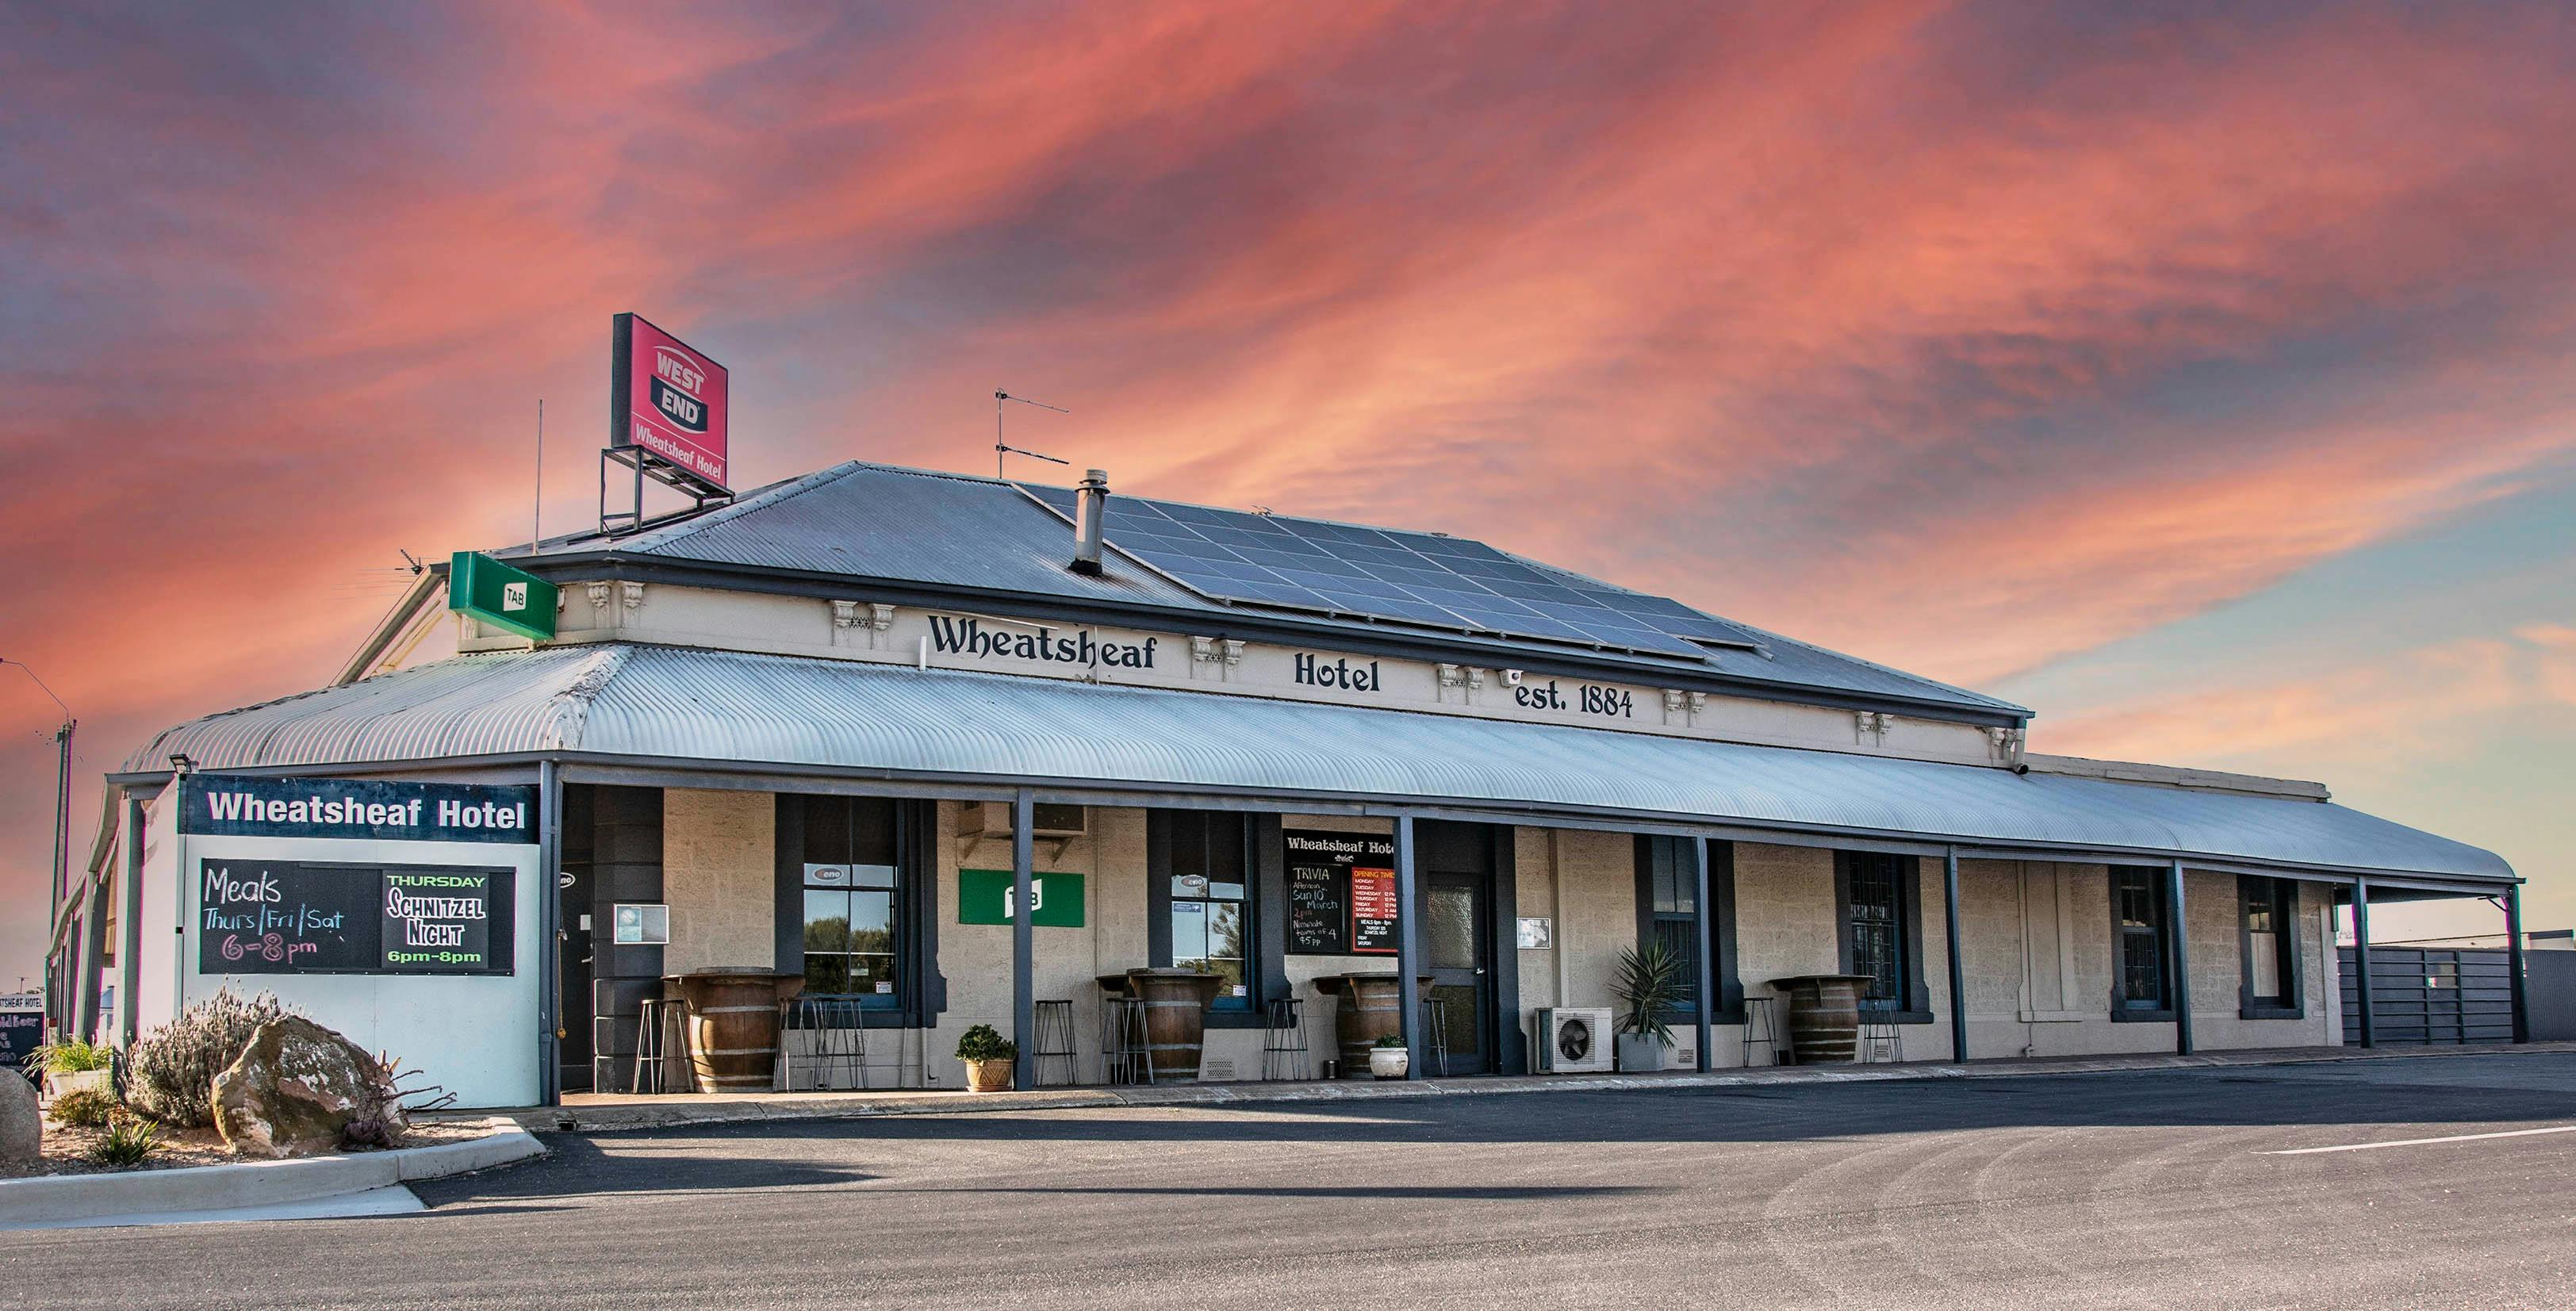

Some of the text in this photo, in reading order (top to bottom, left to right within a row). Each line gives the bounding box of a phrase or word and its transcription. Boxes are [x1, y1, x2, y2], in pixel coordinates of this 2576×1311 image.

[657, 351, 704, 395] WEST
[661, 387, 699, 424] END
[636, 423, 721, 480] Wheatsheaf Hotel
[507, 588, 524, 606] TAB
[928, 615, 1633, 718] Wheatsheaf Hotel est. 1884
[208, 792, 526, 829] Wheatsheaf Hotel
[1286, 837, 1364, 853] Wheatsheaf
[386, 875, 485, 887] THURSDAY
[1293, 868, 1331, 880] TRIVIA
[204, 868, 282, 904] Meals
[1293, 889, 1313, 901] Sun
[1306, 899, 1339, 910] March
[407, 918, 466, 946] NIGHT
[1328, 929, 1336, 940] 4
[387, 951, 481, 964] 6pm-8pm
[25, 998, 43, 1009] HOTEL
